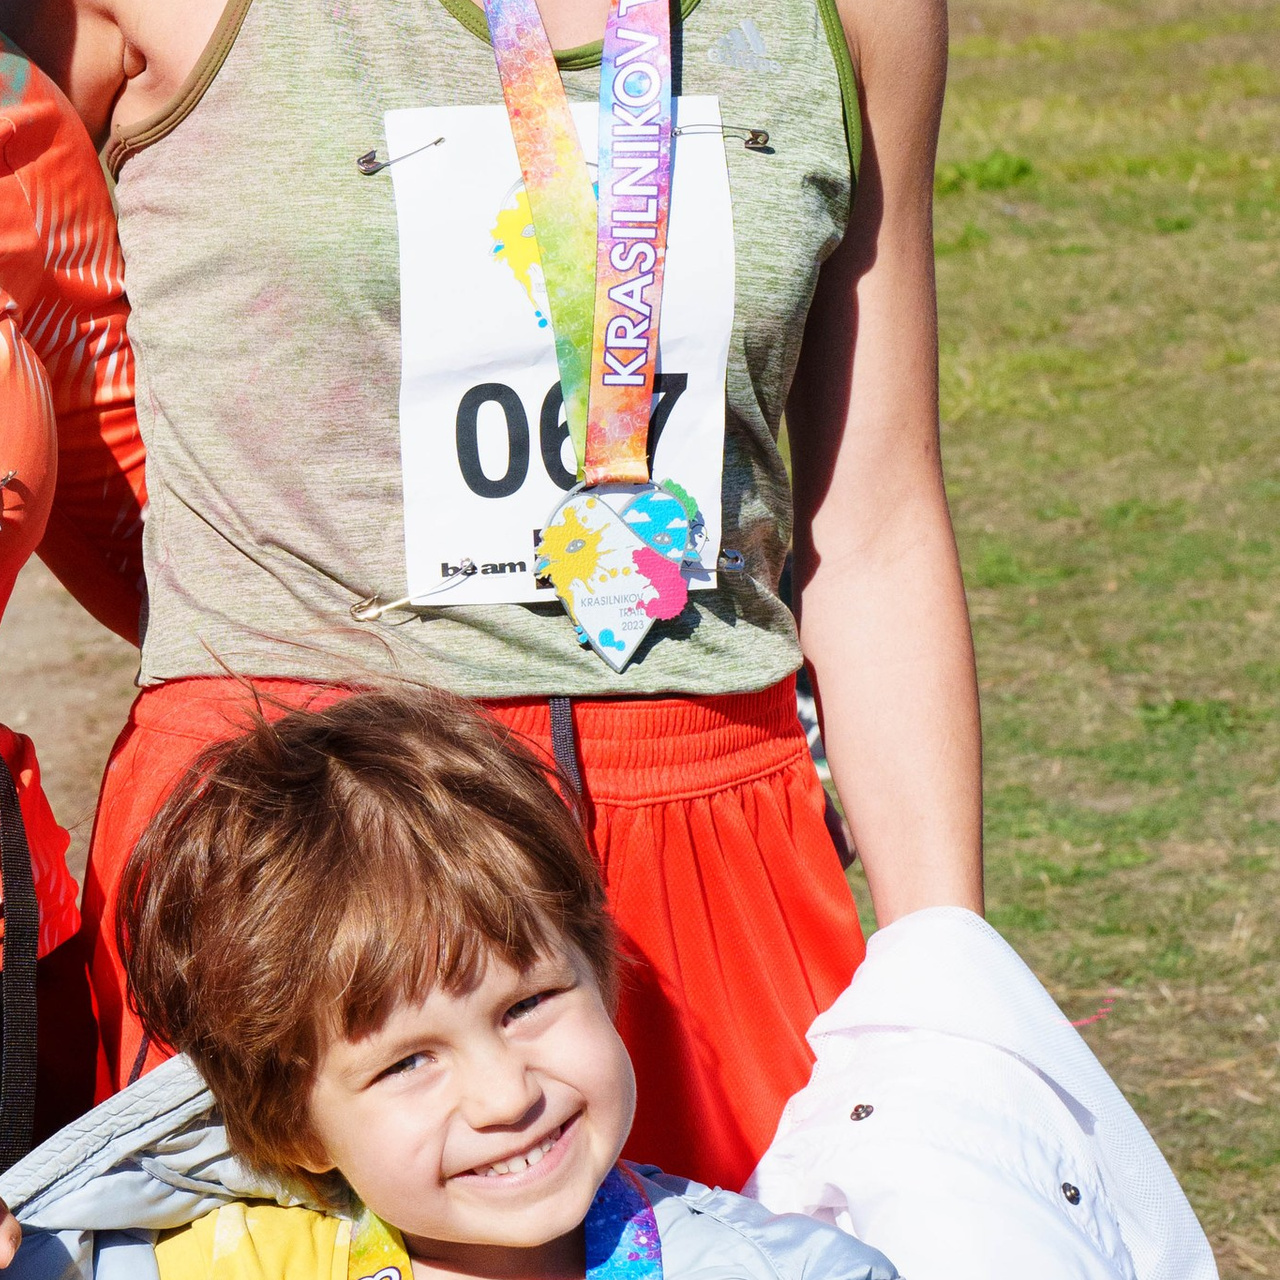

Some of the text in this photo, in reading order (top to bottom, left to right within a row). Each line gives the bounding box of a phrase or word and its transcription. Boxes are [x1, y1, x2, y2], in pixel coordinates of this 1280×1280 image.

[602, 24, 662, 386] KRASILNIKOV
[580, 593, 644, 608] KRASILNIKOV
[622, 621, 644, 631] 2023
